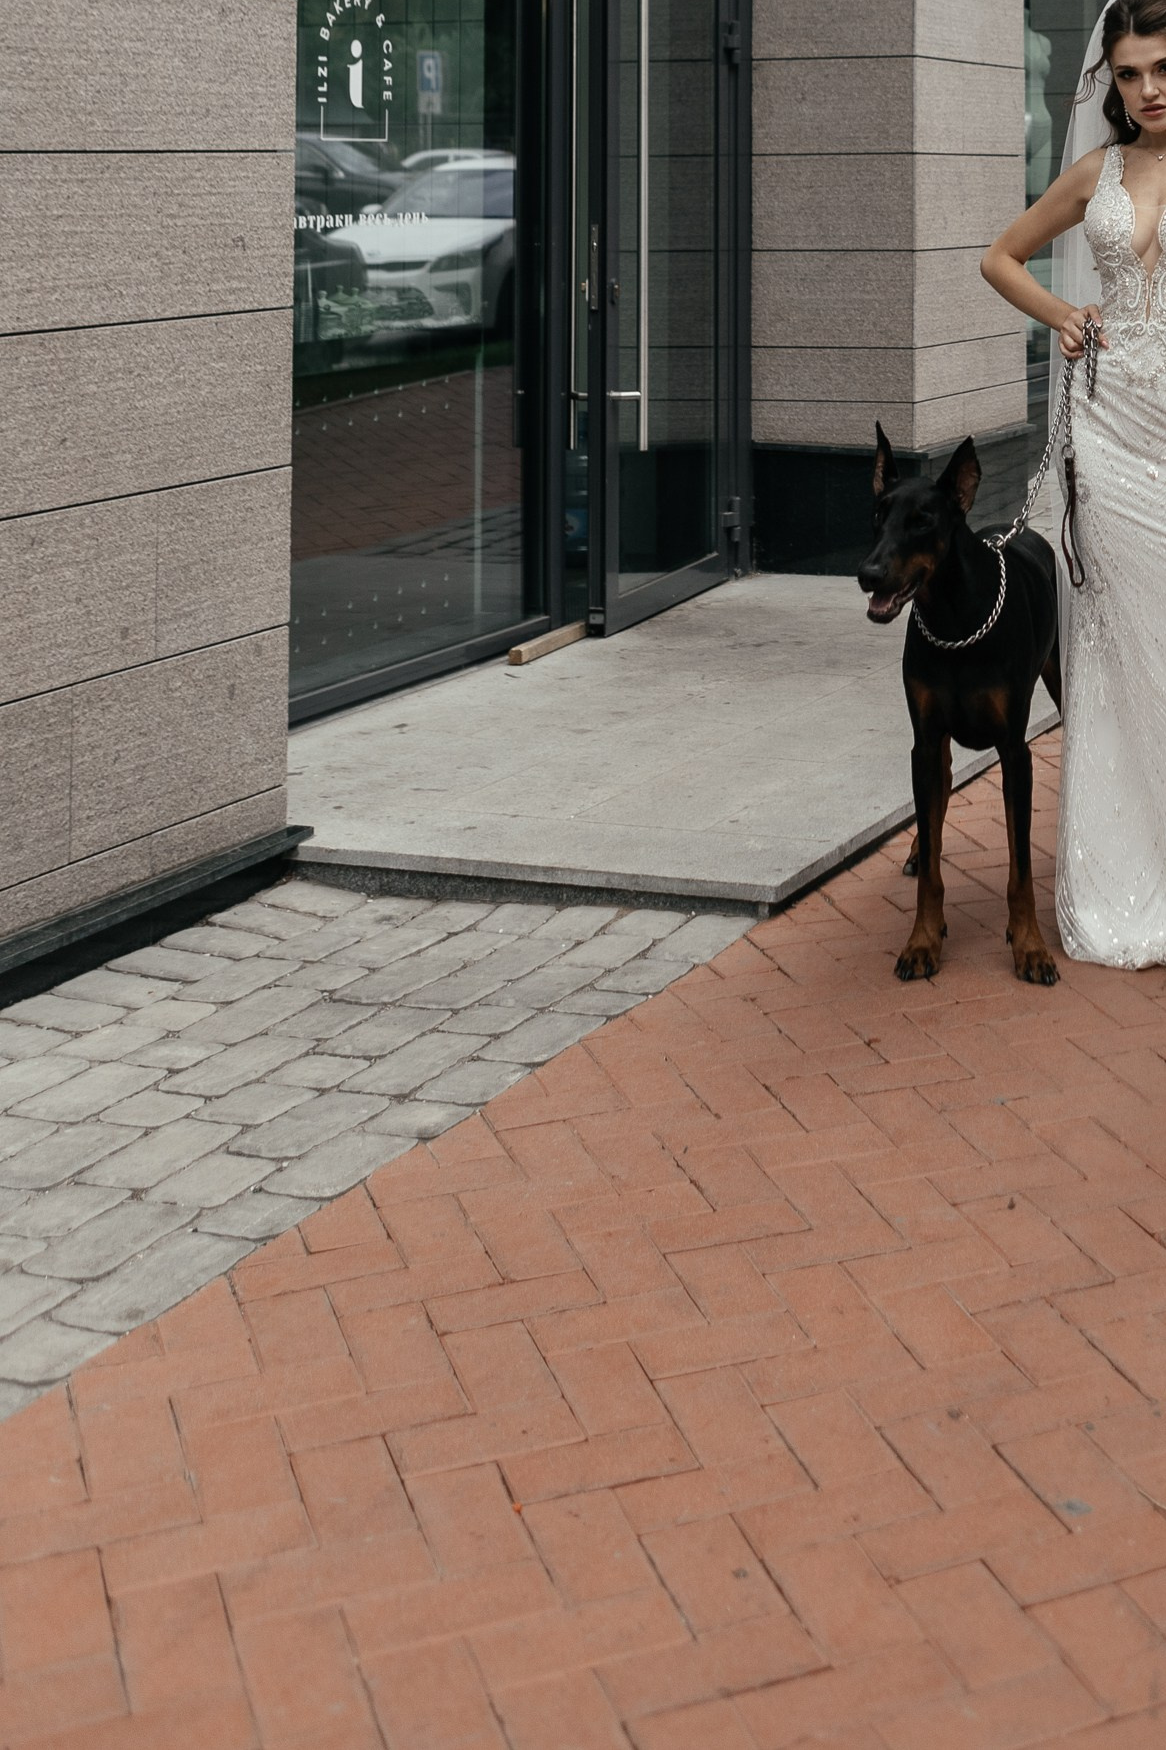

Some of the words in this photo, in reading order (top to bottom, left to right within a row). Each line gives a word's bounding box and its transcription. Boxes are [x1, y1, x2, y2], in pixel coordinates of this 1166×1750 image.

[317, 55, 328, 103] ILZI
[375, 13, 386, 28] &
[383, 39, 393, 101] CAFE
[359, 212, 391, 227] весь
